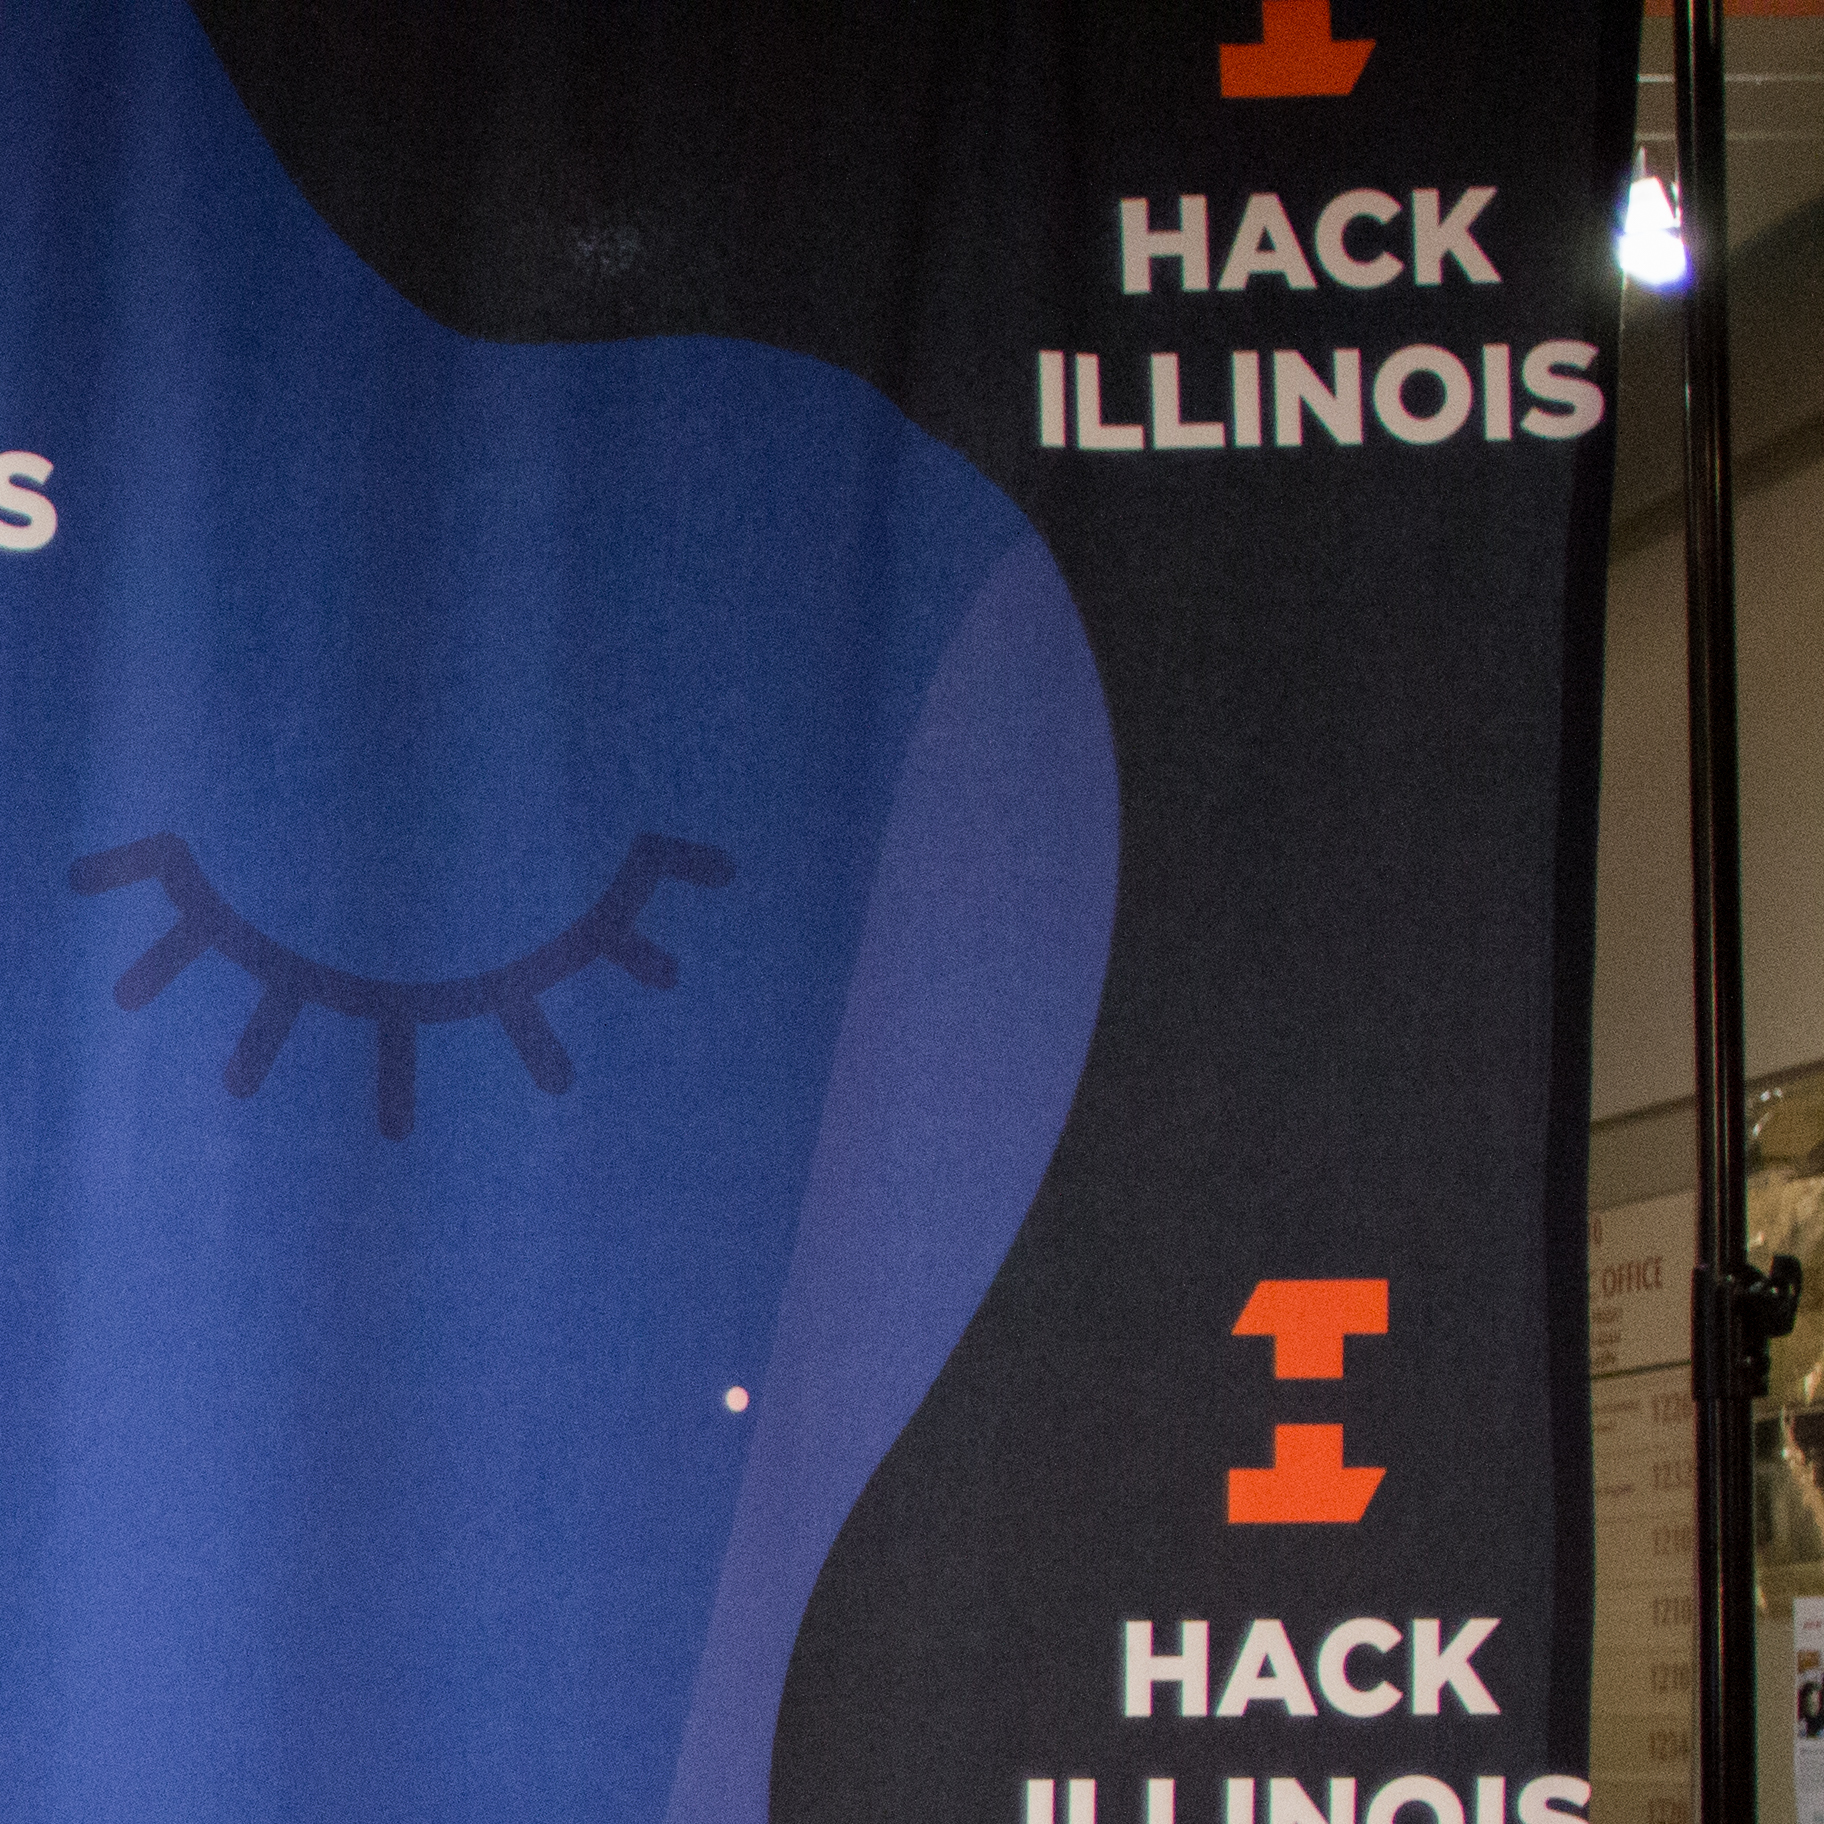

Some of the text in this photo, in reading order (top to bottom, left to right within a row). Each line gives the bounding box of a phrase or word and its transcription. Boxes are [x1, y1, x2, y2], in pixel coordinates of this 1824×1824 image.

[1122, 188, 1502, 294] HACK
[1040, 341, 1604, 449] ILLINOIS
[1123, 1617, 1500, 1718] HACK
